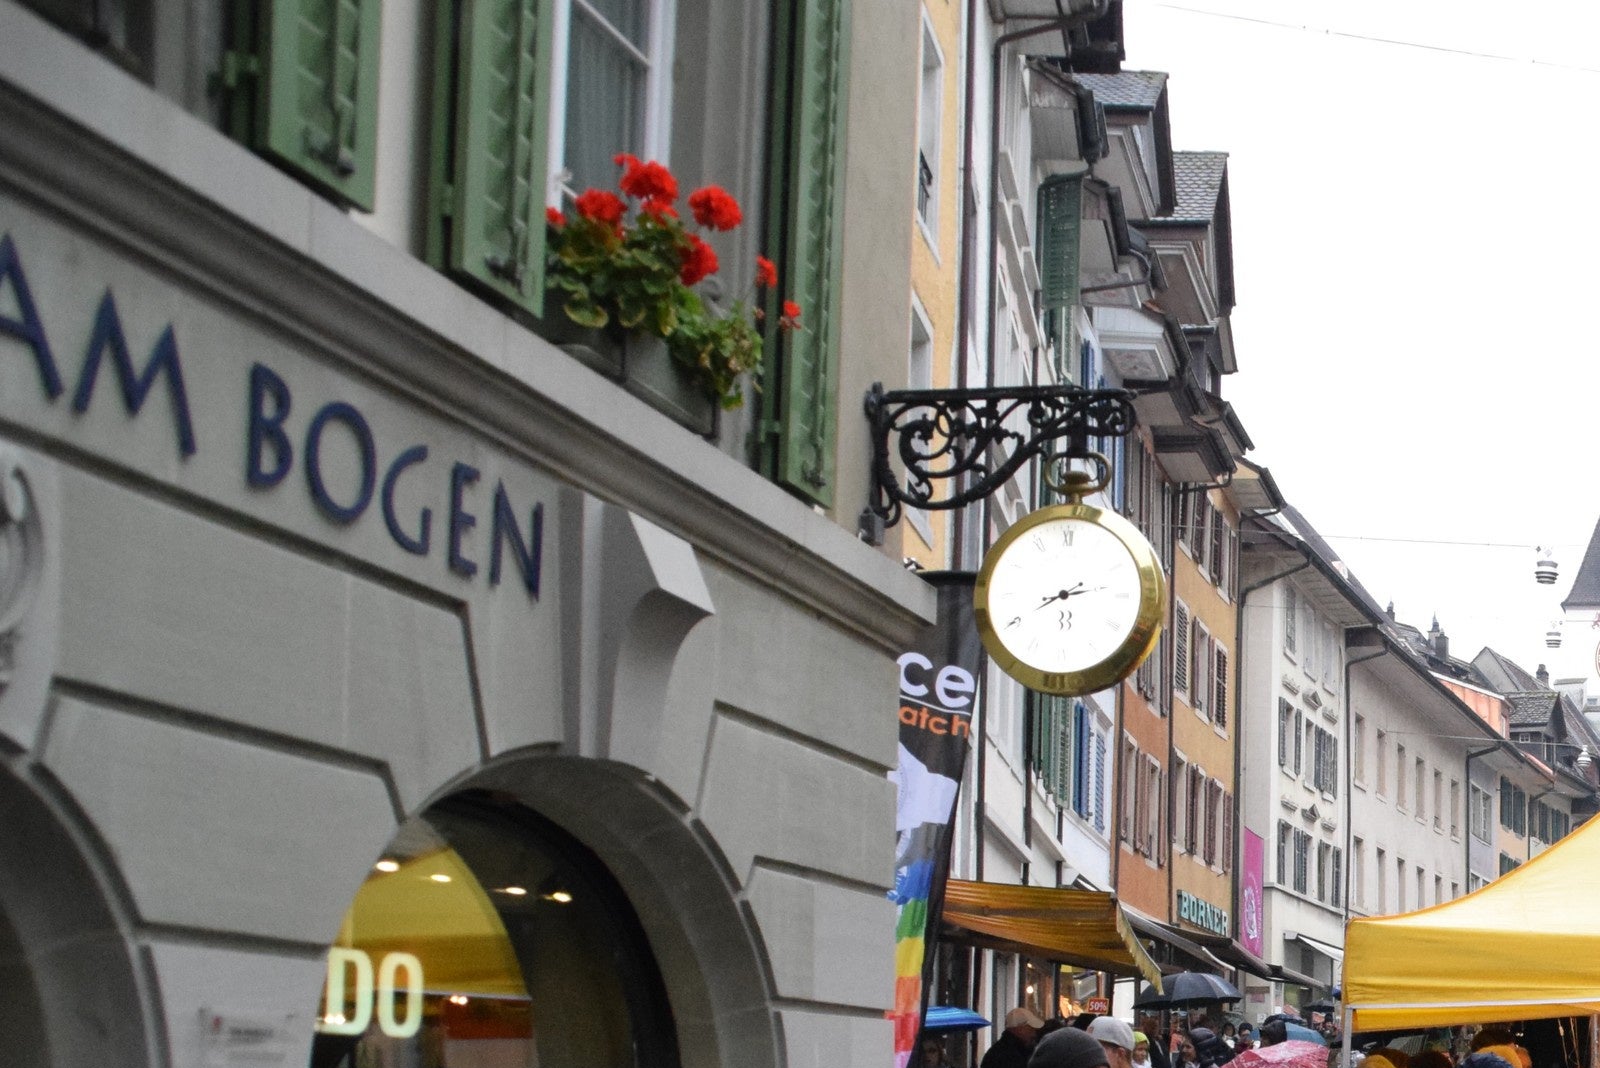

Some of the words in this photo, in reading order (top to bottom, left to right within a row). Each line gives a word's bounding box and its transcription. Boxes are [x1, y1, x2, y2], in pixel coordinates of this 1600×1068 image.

[0, 234, 196, 461] AM
[245, 361, 545, 604] BOGEN
[1181, 890, 1228, 938] BORNER
[1089, 1001, 1107, 1012] 50%
